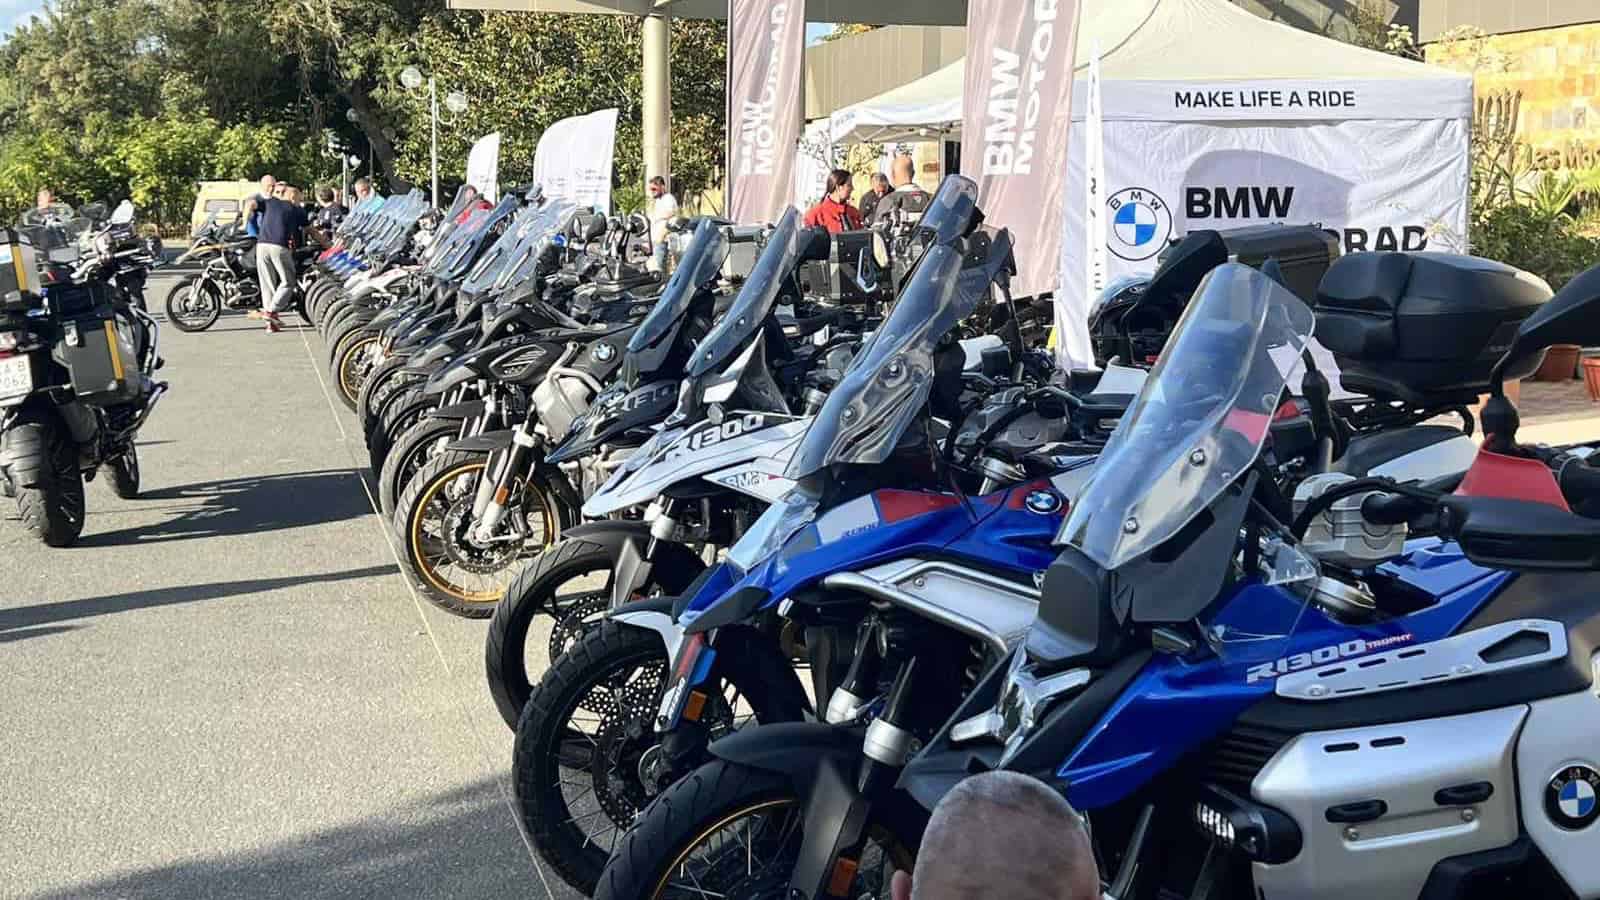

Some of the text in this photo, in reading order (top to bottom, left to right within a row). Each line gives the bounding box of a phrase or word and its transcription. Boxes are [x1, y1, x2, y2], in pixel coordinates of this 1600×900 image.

[983, 47, 1021, 176] BMW
[1175, 91, 1356, 108] MAKE LIFE A RIDE
[1109, 190, 1162, 211] BMW
[1186, 187, 1295, 219] BMW
[1367, 632, 1414, 650] TROPHY
[1246, 639, 1367, 684] R1300
